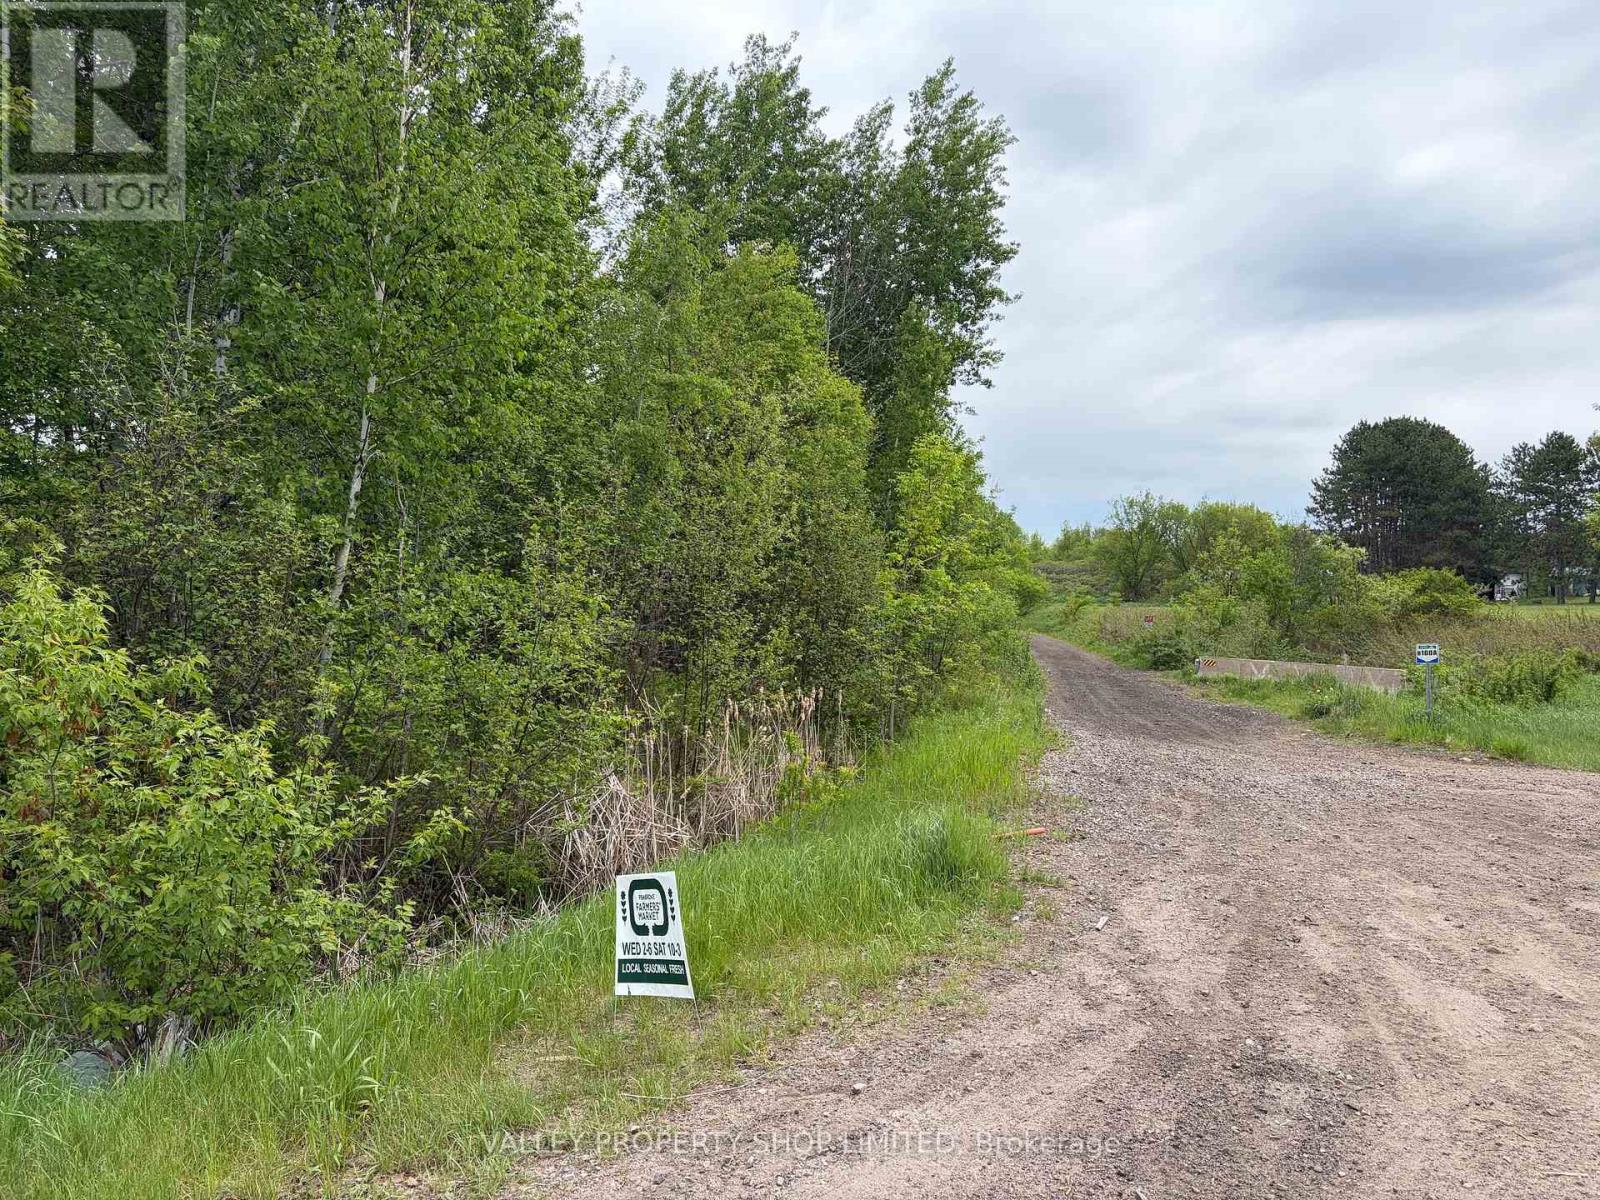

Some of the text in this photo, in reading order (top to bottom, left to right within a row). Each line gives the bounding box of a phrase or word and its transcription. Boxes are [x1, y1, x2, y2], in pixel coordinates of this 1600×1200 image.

[638, 912, 659, 920] MARKET
[622, 942, 682, 957] WED 2-6 SAT 10-3
[622, 963, 685, 975] LOCAL SEASONAL FRESH
